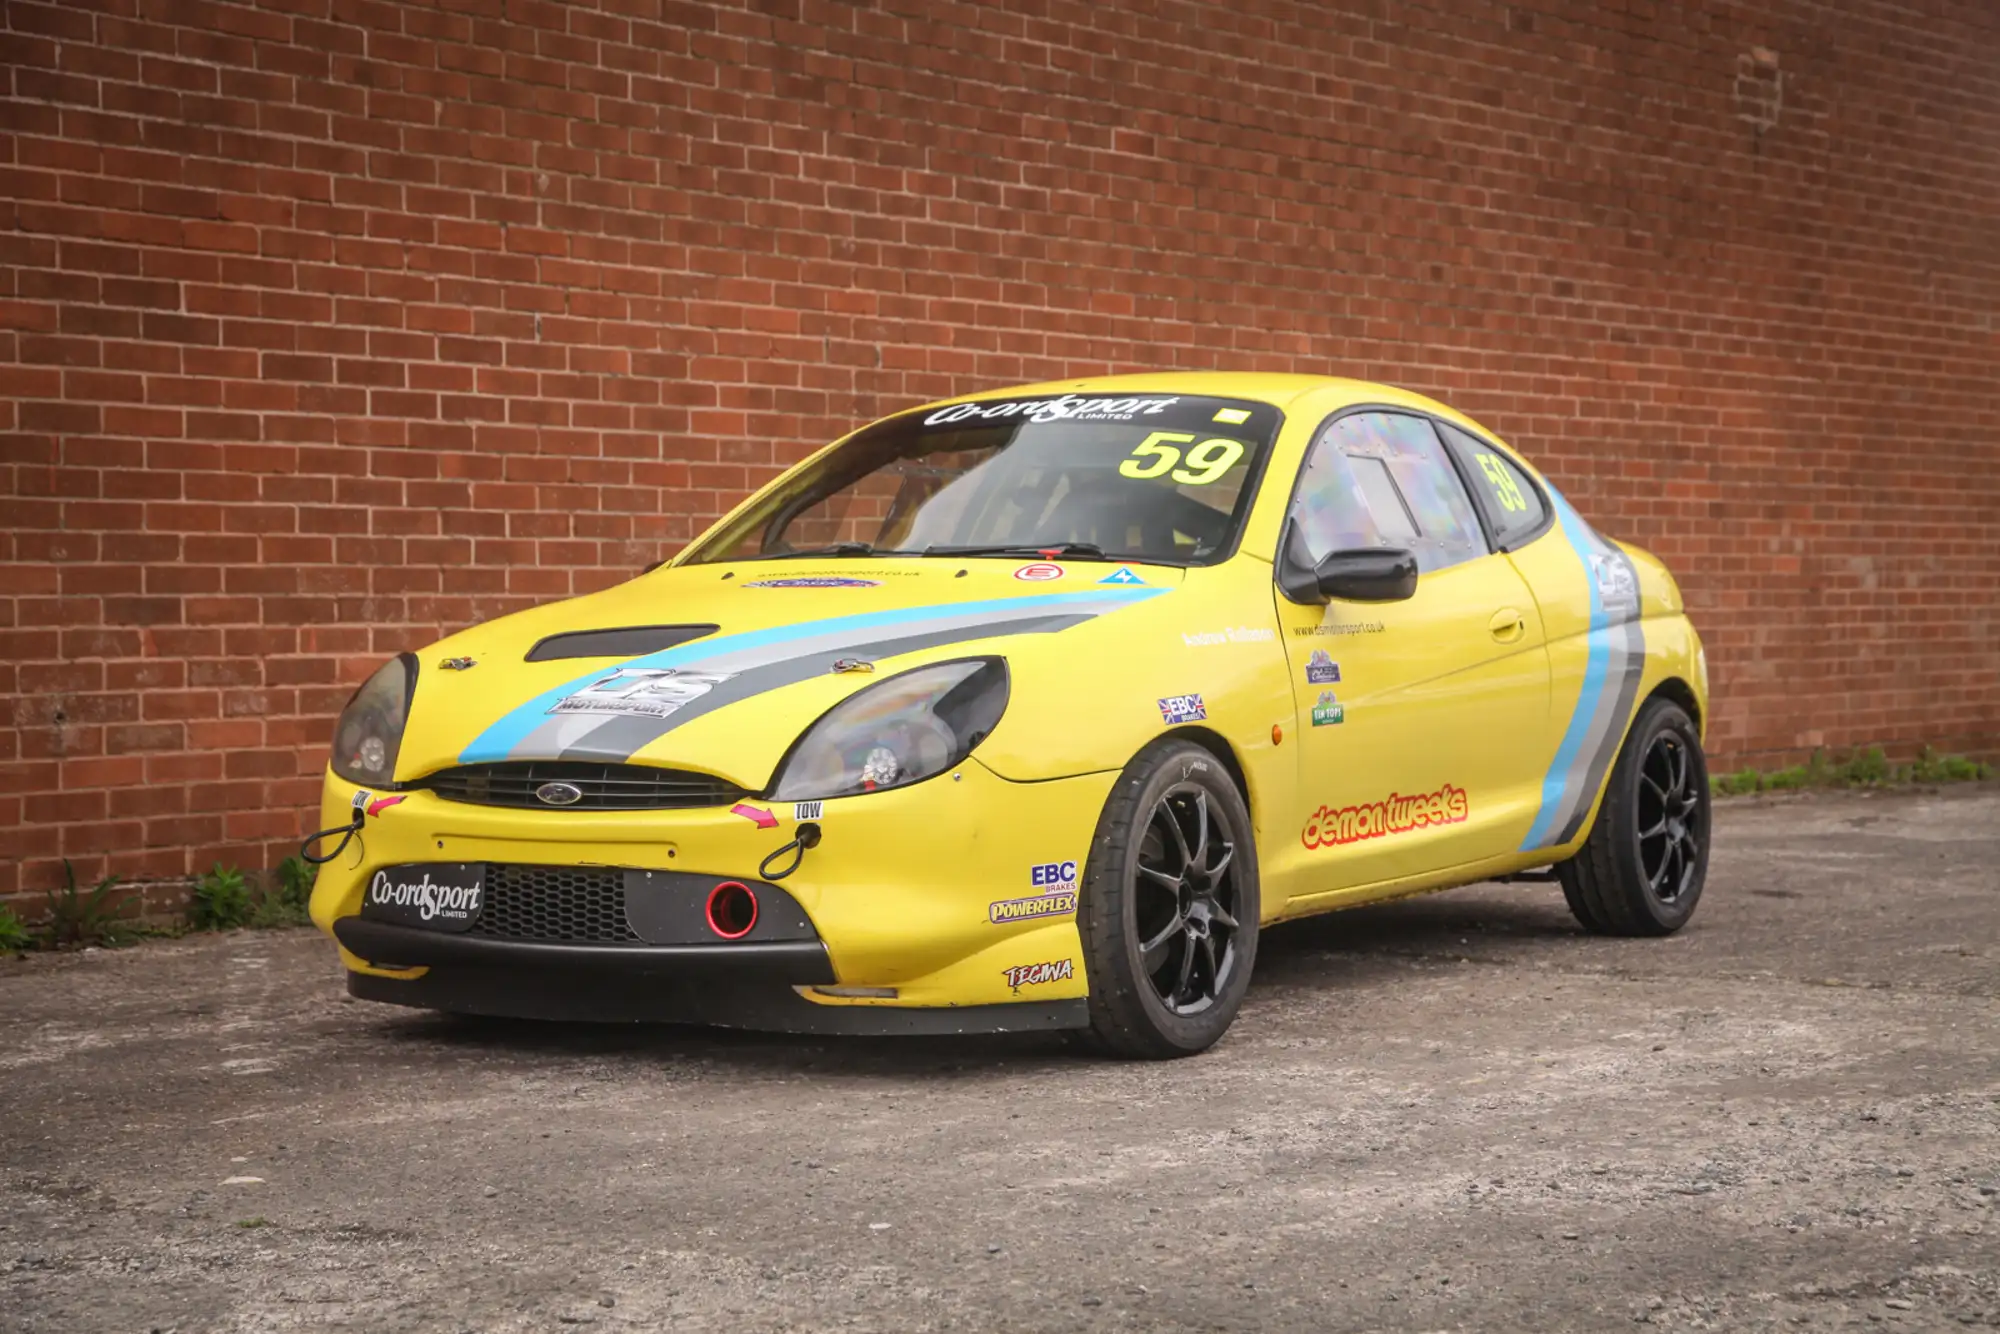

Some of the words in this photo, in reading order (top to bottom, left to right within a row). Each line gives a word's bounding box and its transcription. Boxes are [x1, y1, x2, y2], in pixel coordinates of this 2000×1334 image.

[1077, 413, 1133, 421] LIMITED
[1119, 432, 1244, 486] 59
[1474, 453, 1527, 513] 59
[1168, 695, 1197, 716] EBC
[795, 802, 822, 819] TOW
[1301, 805, 1386, 850] demon
[1384, 783, 1468, 835] tweeks
[1031, 862, 1076, 886] EBC
[1045, 882, 1076, 893] BRAKES
[441, 910, 468, 919] LIMITED
[992, 893, 1074, 921] POWERFLEX
[1003, 957, 1074, 988] TEGIWA
